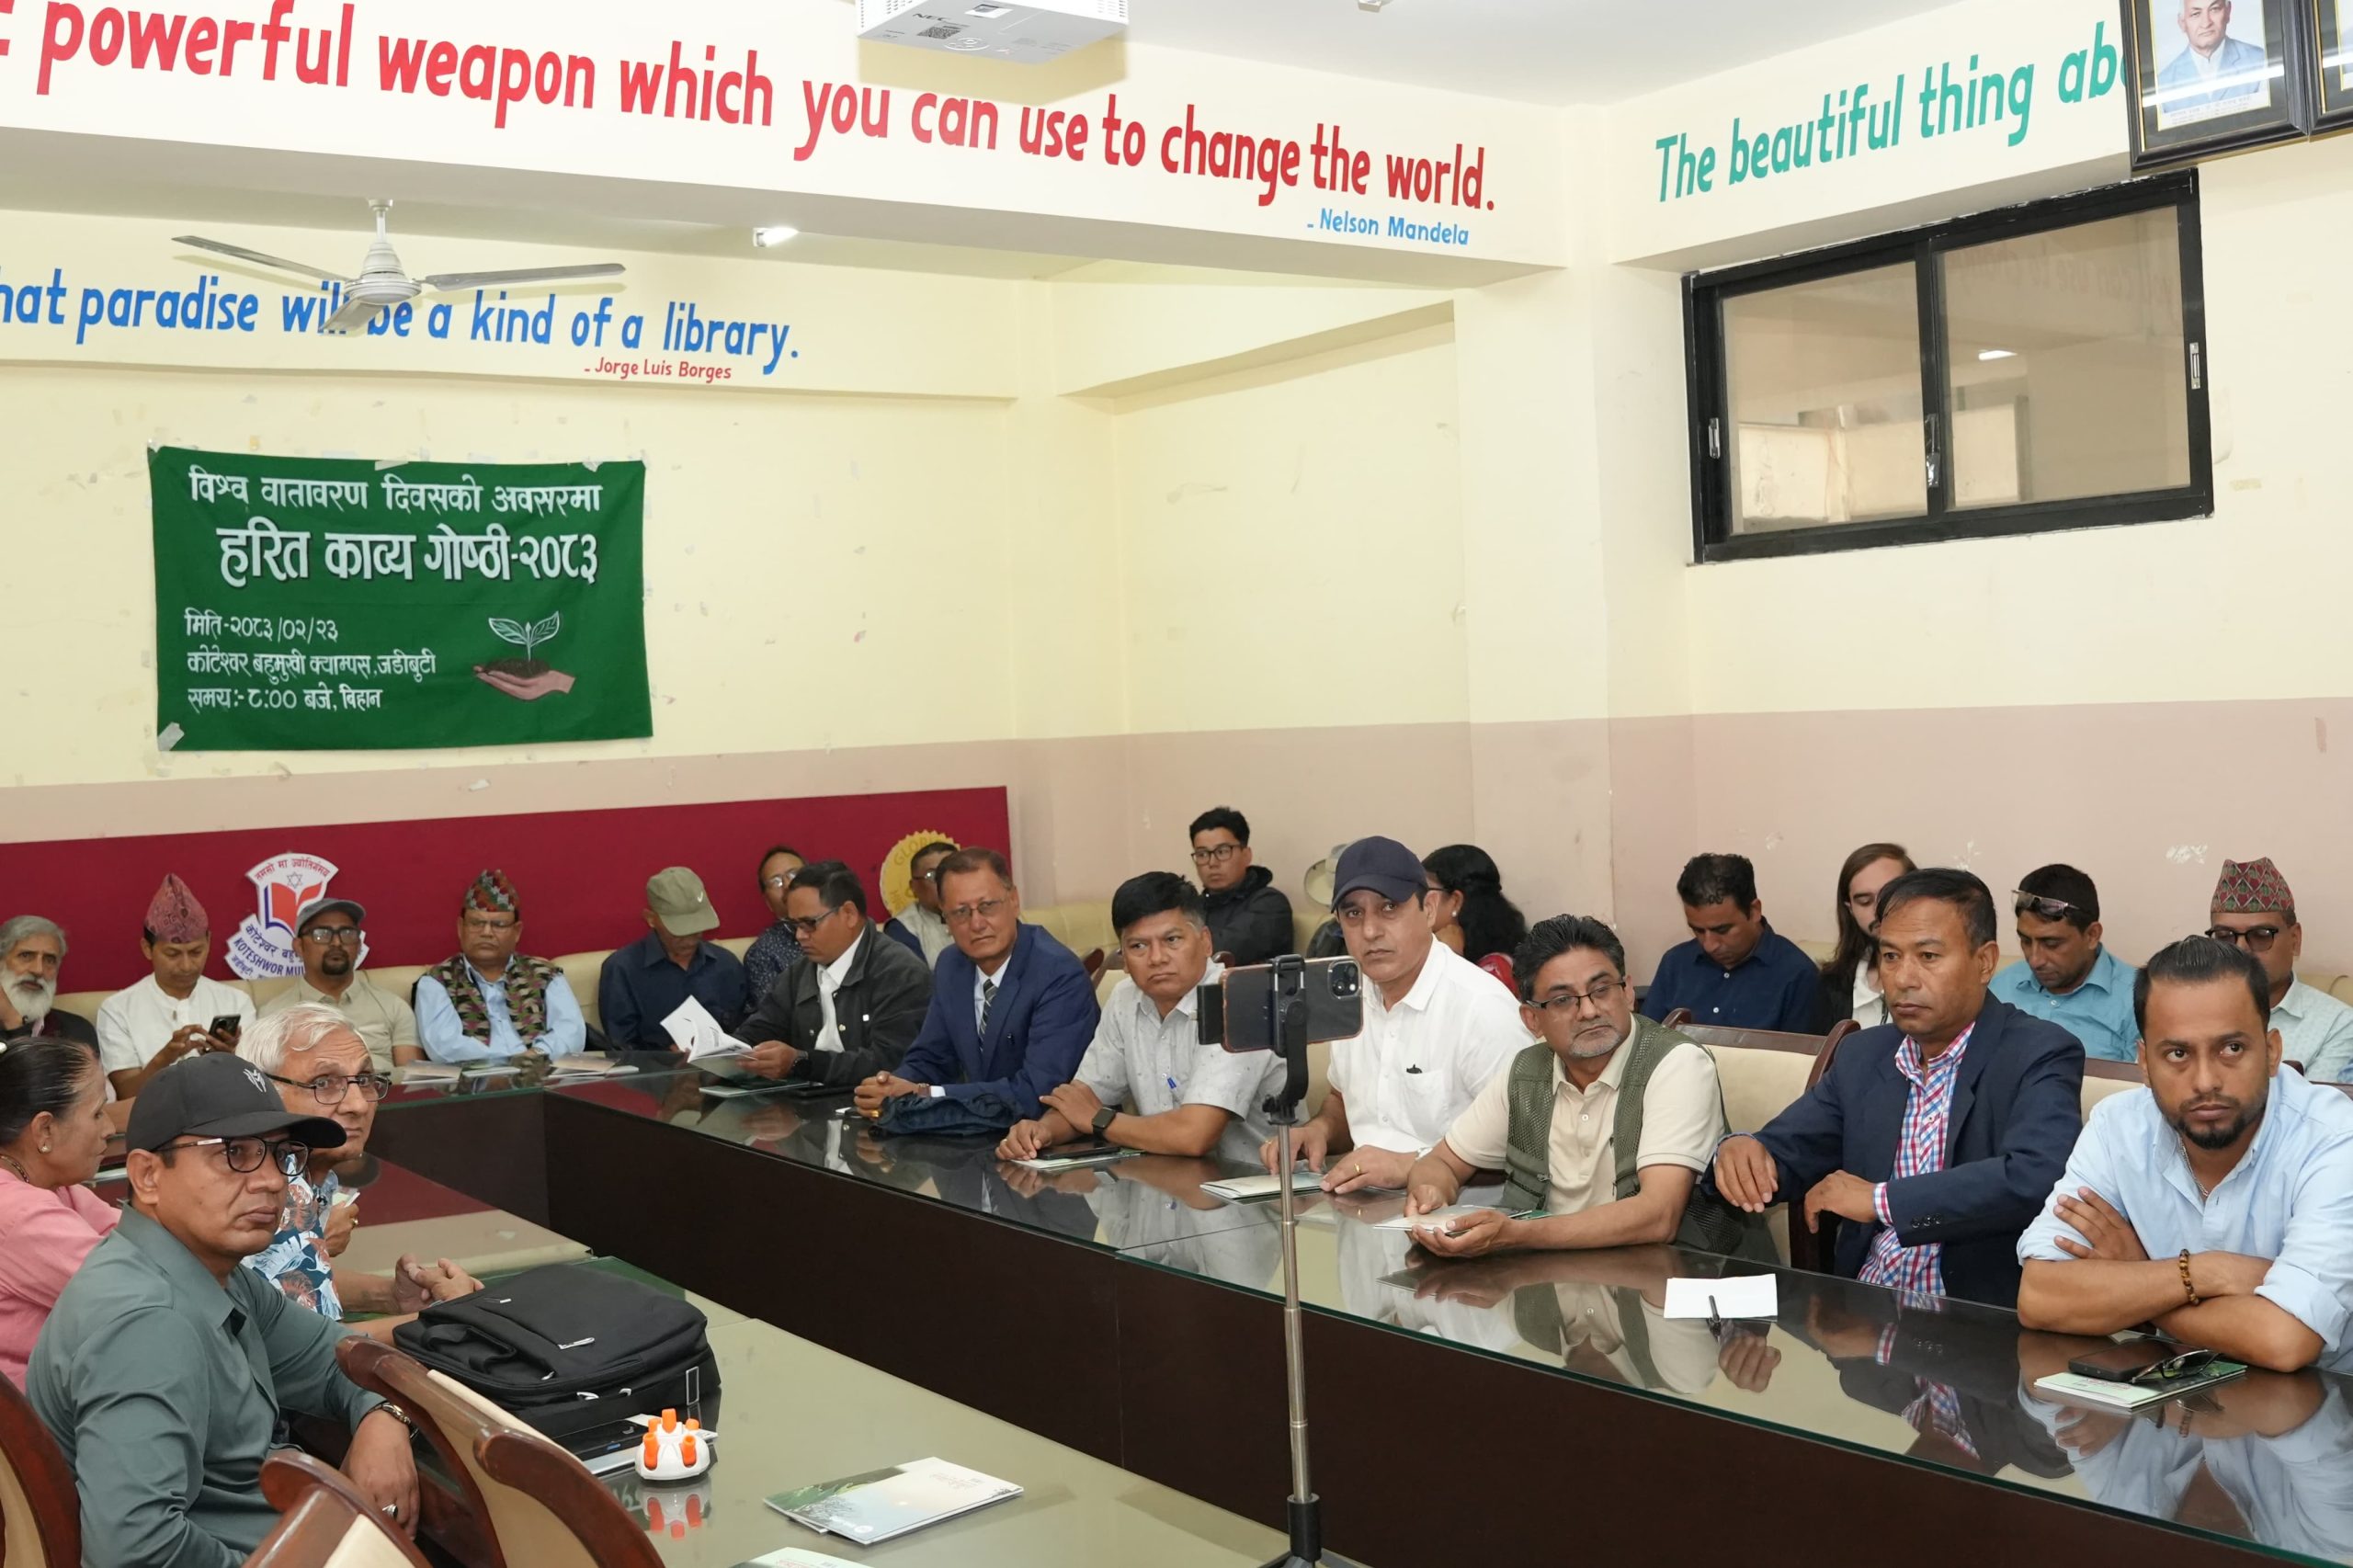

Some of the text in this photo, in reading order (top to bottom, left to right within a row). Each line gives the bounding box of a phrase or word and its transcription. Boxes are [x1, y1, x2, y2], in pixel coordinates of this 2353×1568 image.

[37, 0, 355, 96] powerful
[379, 35, 596, 129] weapon
[620, 40, 773, 126] which
[793, 80, 891, 162] you
[912, 92, 998, 149] can
[1019, 107, 1088, 162] use
[1102, 93, 1146, 166] to
[1161, 103, 1301, 207] change
[1310, 123, 1370, 195] the
[1386, 143, 1495, 211] world.
[1654, 20, 2128, 202] The beautiful thing ab
[1320, 208, 1379, 235] Nelson
[1387, 216, 1469, 246] Mandela
[76, 275, 259, 345] paradise
[427, 303, 453, 339] a
[471, 290, 555, 345] kind
[571, 297, 613, 347] of
[621, 315, 643, 349] a
[664, 301, 801, 375] library.
[595, 357, 639, 381] Jorge
[643, 358, 672, 376] Luis
[678, 360, 732, 383] Borges
[188, 463, 604, 517] विश्व वातावरण दिवसको अवसरमा
[215, 515, 312, 587] हरित
[324, 531, 417, 580] काव्य
[187, 643, 252, 677] कोटेश्वर
[252, 647, 307, 686] बहुमुखी
[233, 937, 284, 976] KOTESHWOR
[245, 923, 279, 958] कोटेश्वर
